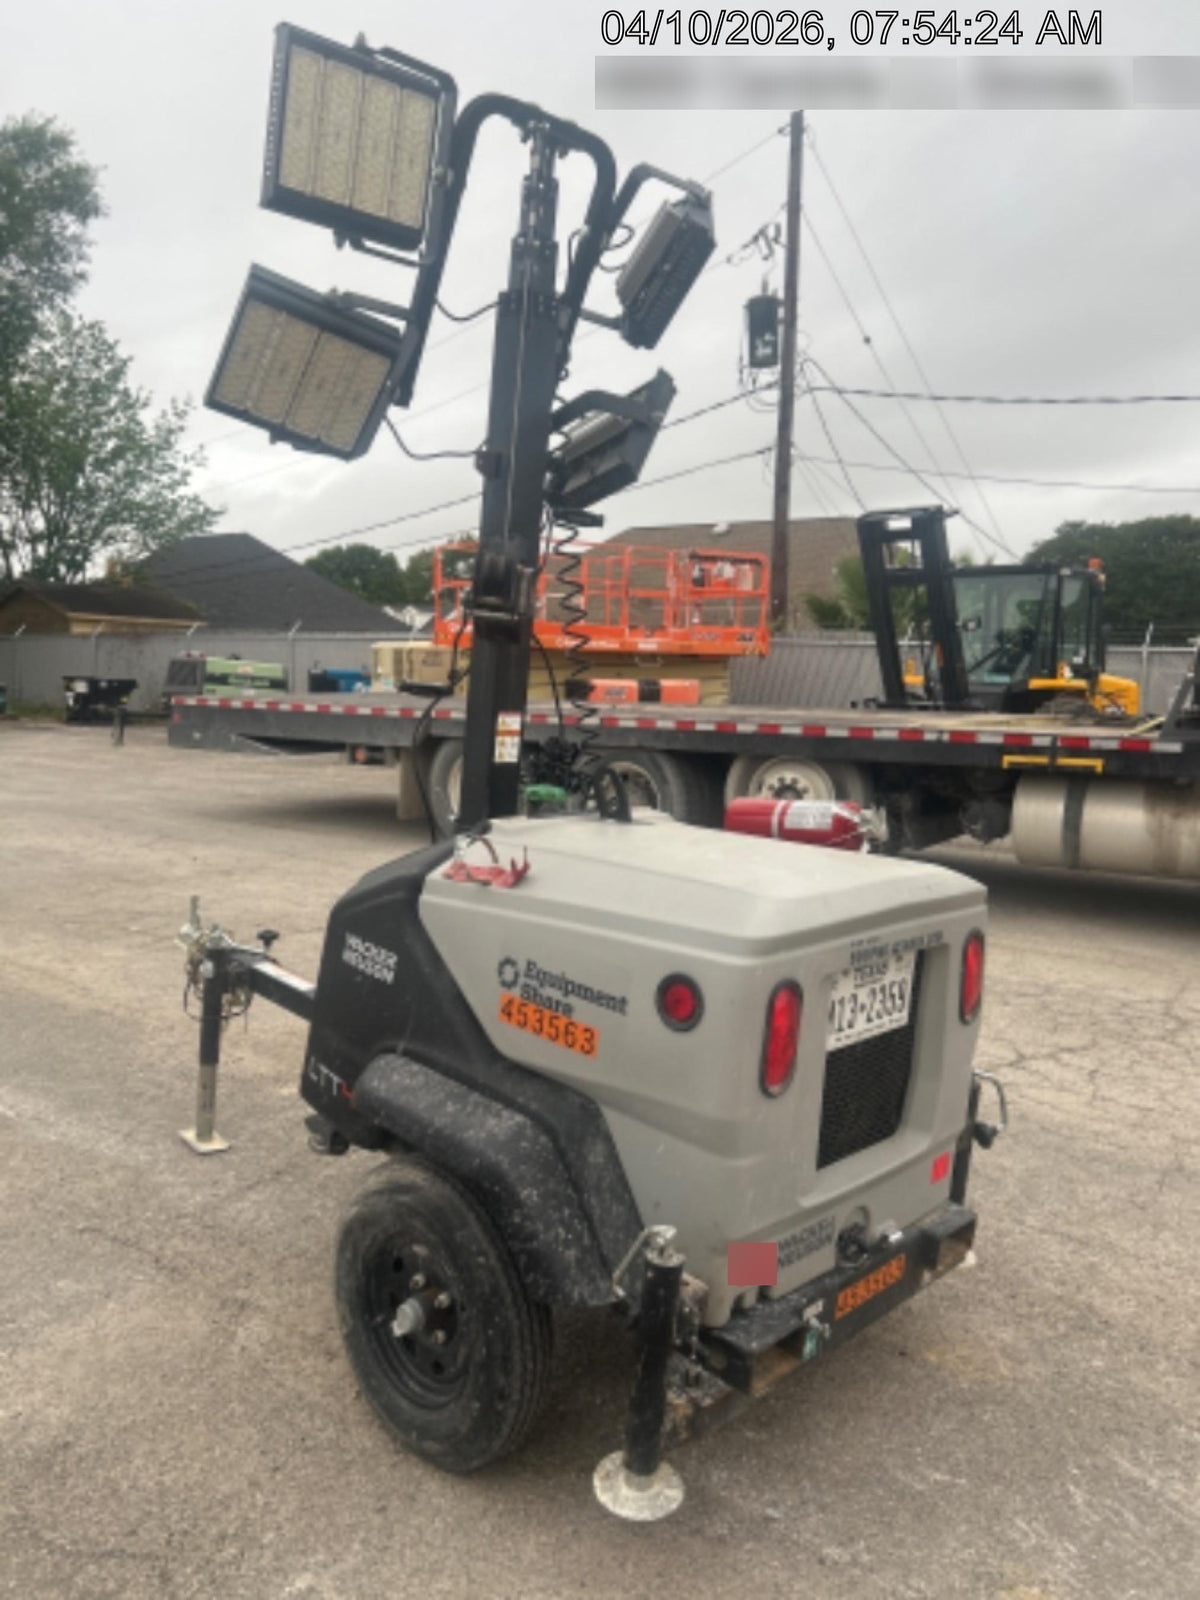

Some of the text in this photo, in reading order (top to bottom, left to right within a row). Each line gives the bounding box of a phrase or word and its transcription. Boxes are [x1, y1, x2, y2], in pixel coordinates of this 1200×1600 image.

[521, 982, 573, 1017] Share
[524, 959, 627, 1016] Equipment
[501, 997, 595, 1055] 453563
